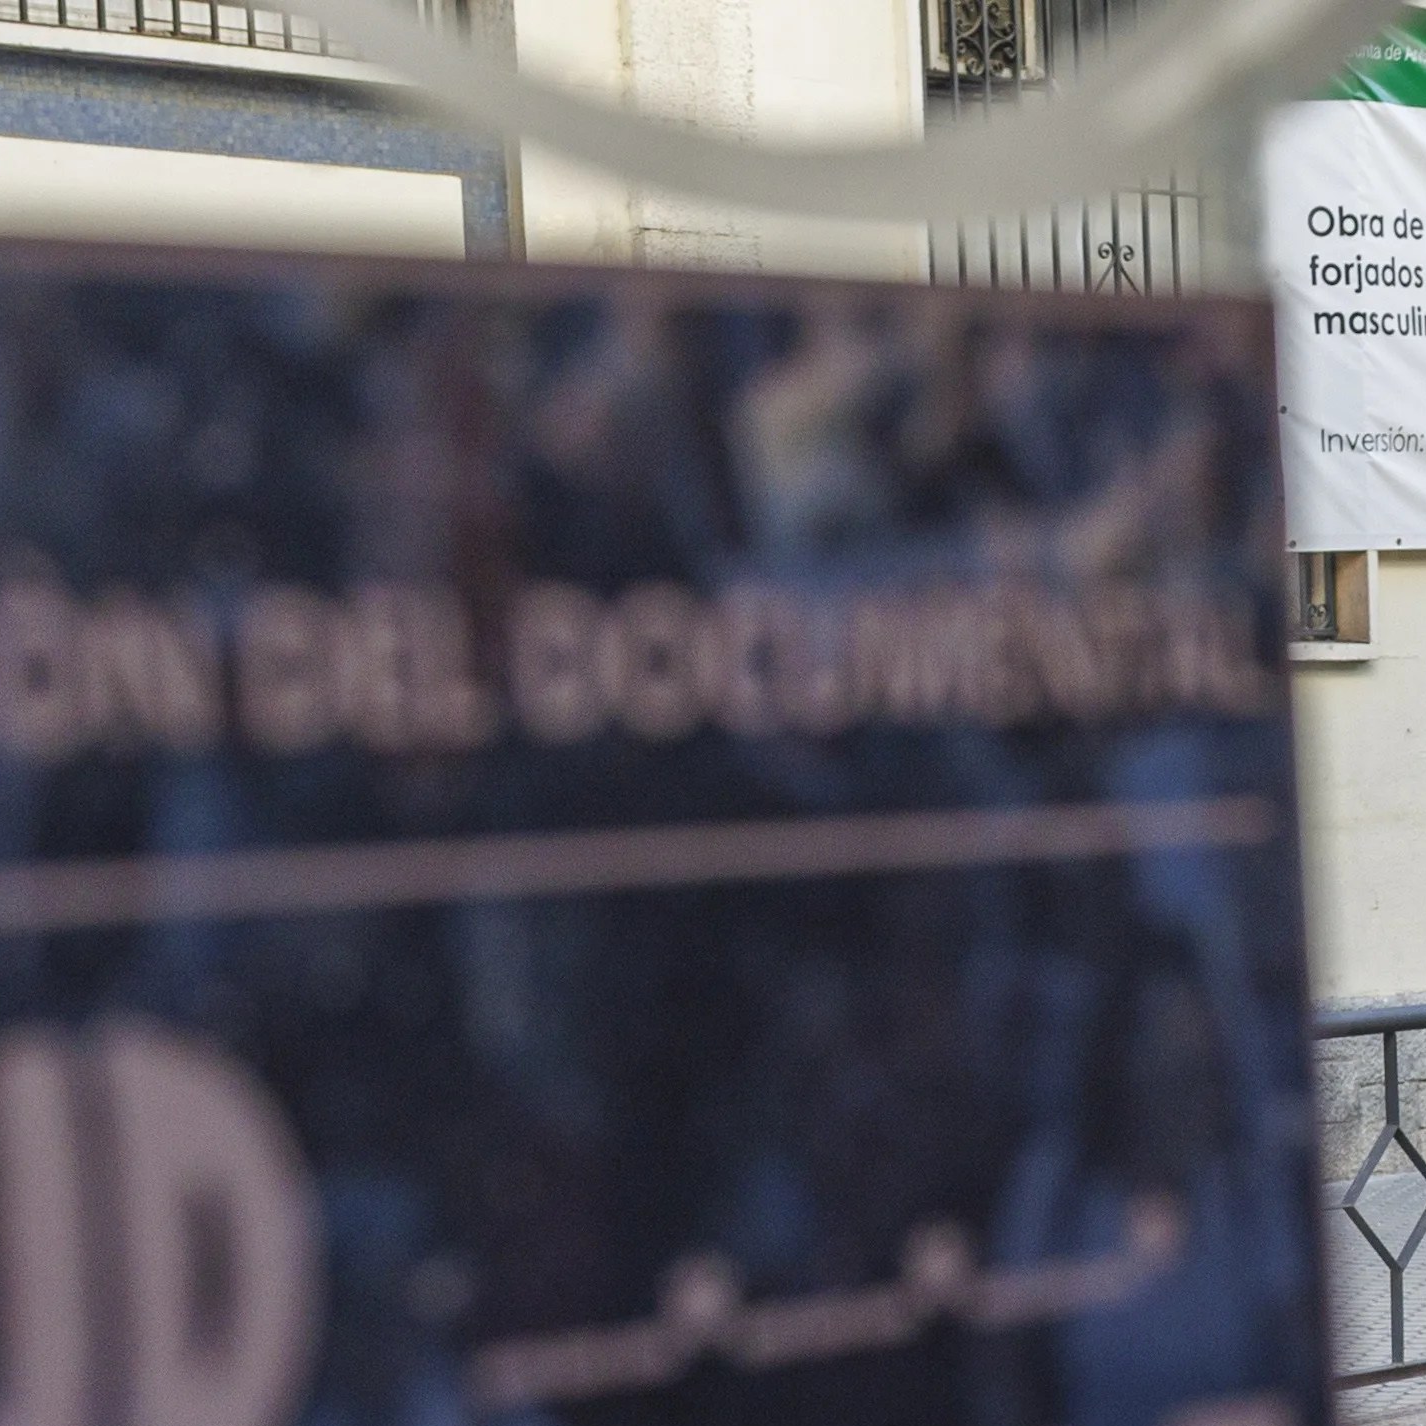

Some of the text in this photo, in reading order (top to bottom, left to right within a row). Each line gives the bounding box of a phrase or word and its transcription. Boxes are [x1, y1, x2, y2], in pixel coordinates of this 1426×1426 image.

[1384, 44, 1402, 61] de
[1307, 206, 1384, 237] Obra
[1394, 208, 1423, 240] de
[1309, 254, 1423, 293] forjados
[1321, 426, 1424, 453] Inversión:
[235, 580, 507, 755] DEL
